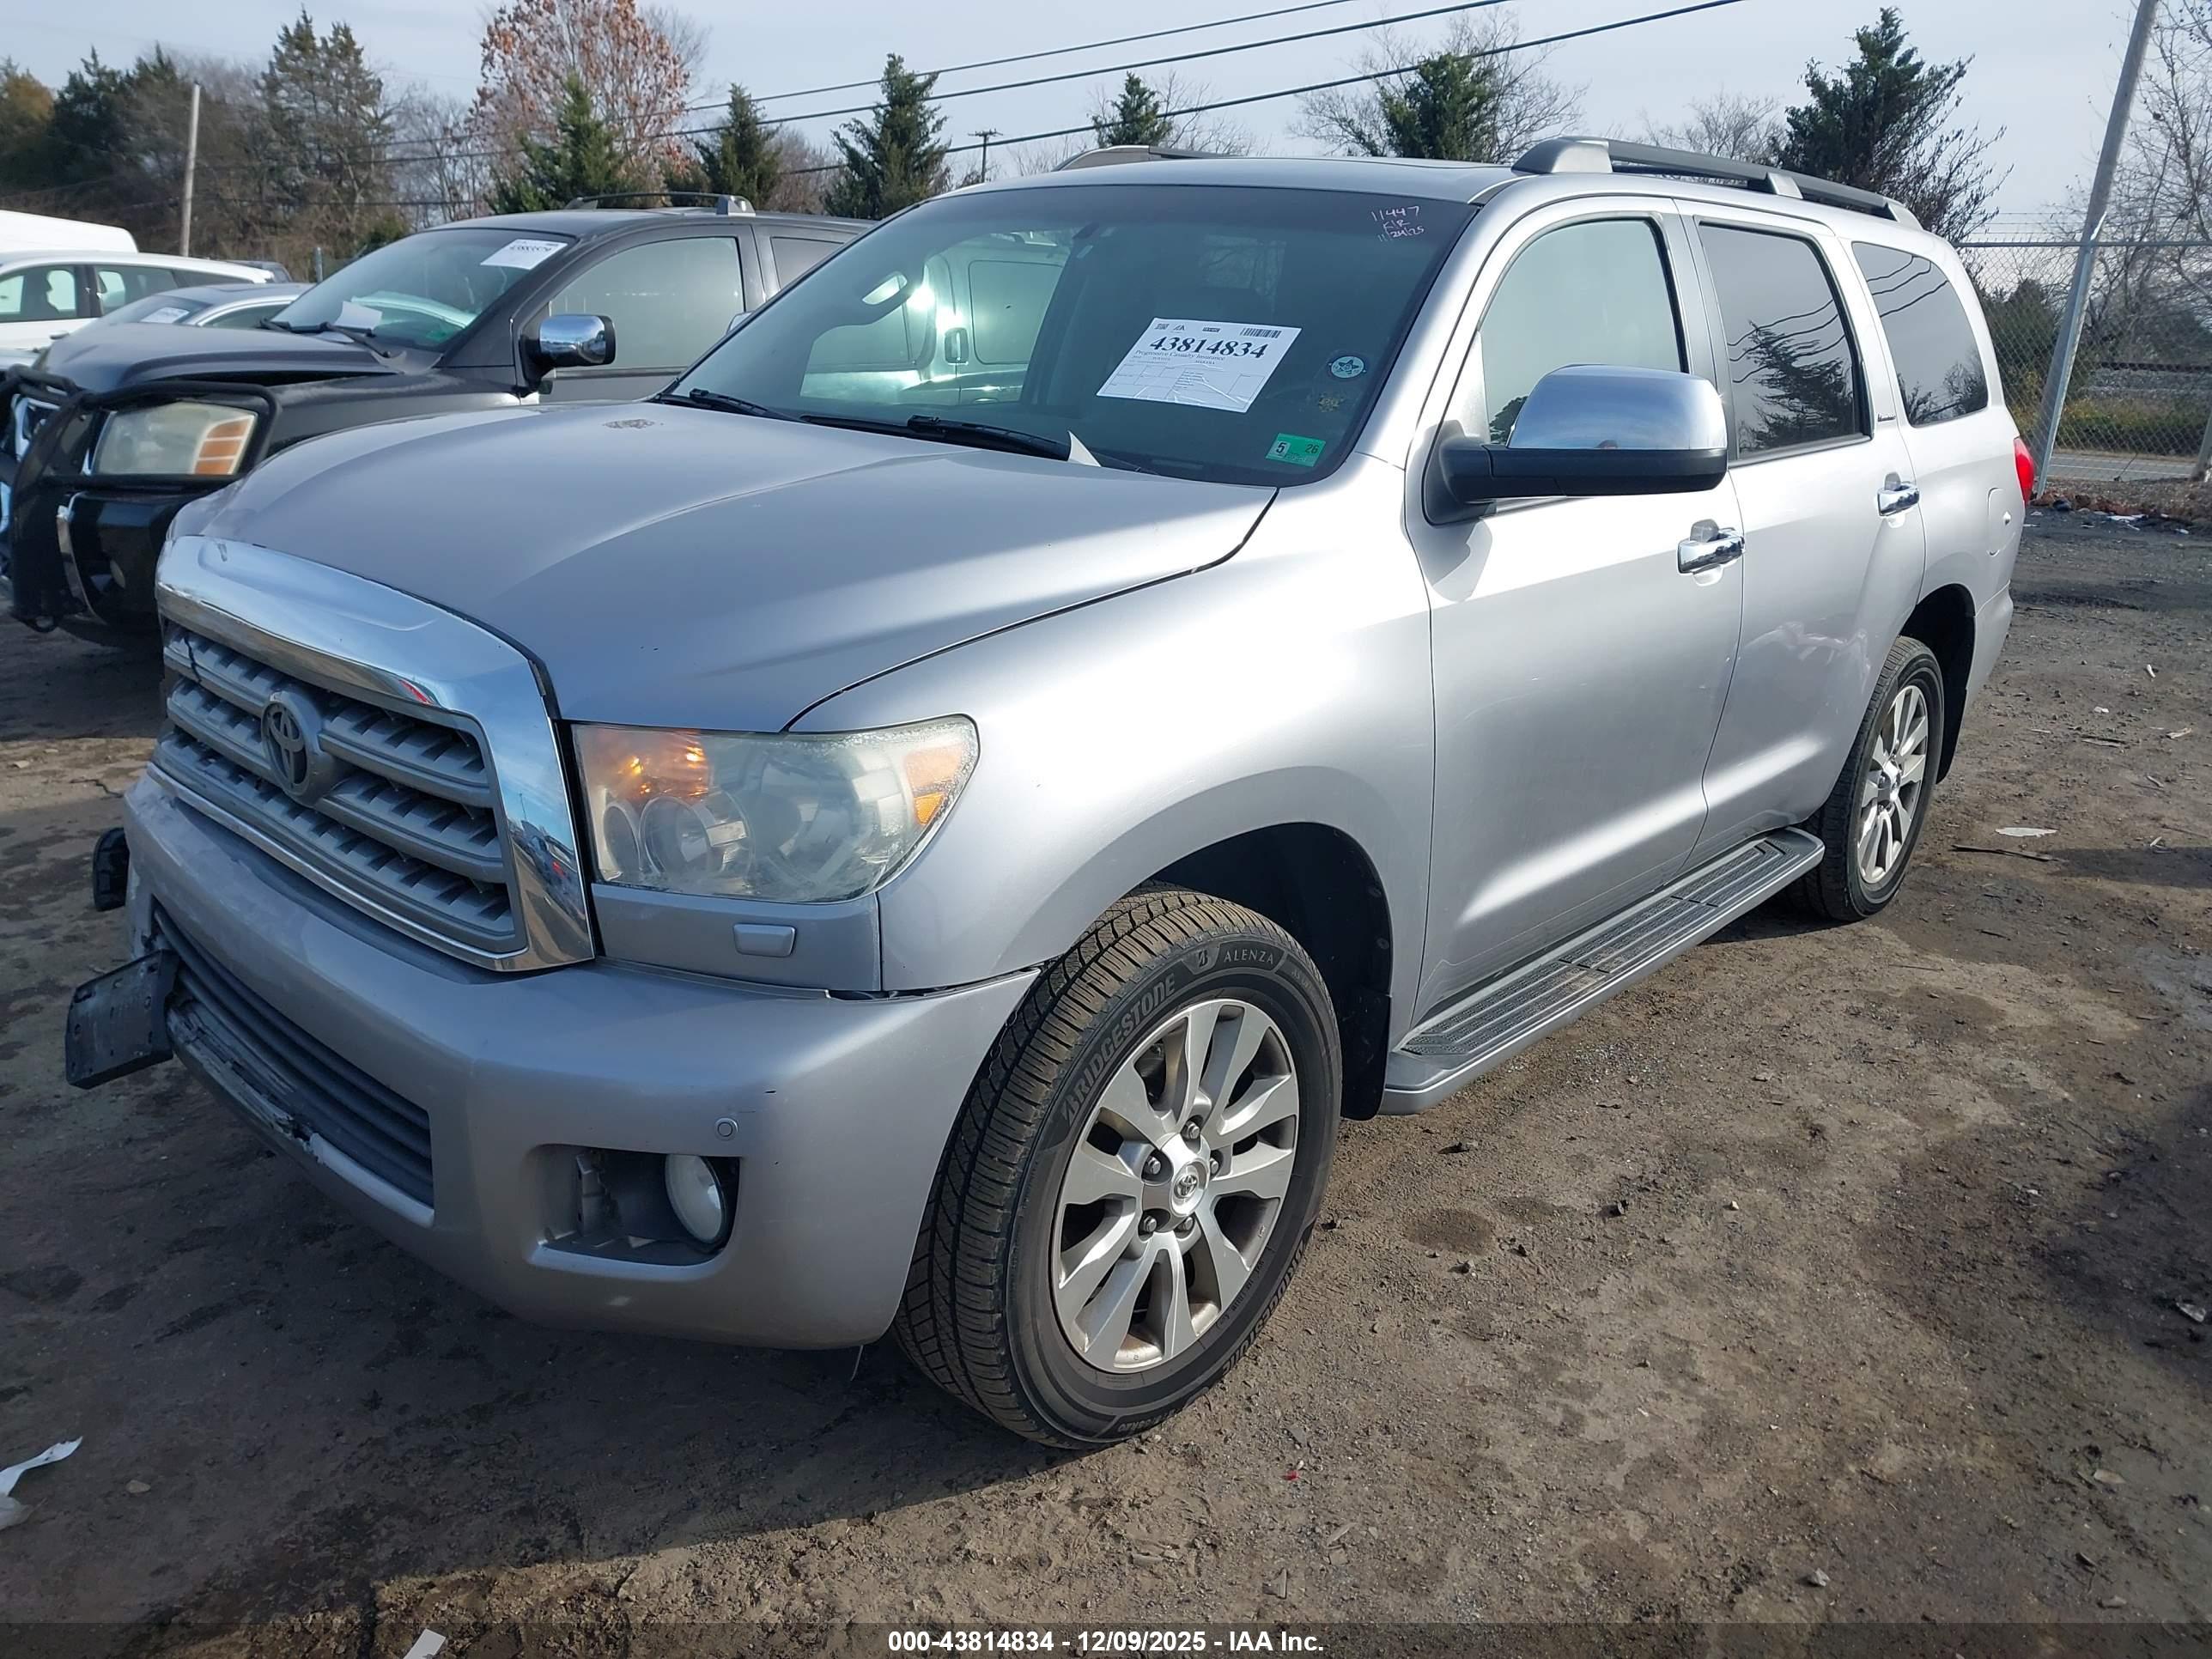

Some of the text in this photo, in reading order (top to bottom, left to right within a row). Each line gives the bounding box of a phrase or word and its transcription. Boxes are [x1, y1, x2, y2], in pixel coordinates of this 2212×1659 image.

[1370, 205, 1420, 222] 11447
[1134, 349, 1170, 357] Progressive
[1169, 351, 1196, 360] Casualty
[1195, 353, 1226, 362] Insurance
[1149, 335, 1270, 359] 43814834
[1275, 441, 1321, 454] 5 26
[1224, 948, 1274, 965] ALENZA
[1060, 972, 1176, 1126] BRIDGESTONE
